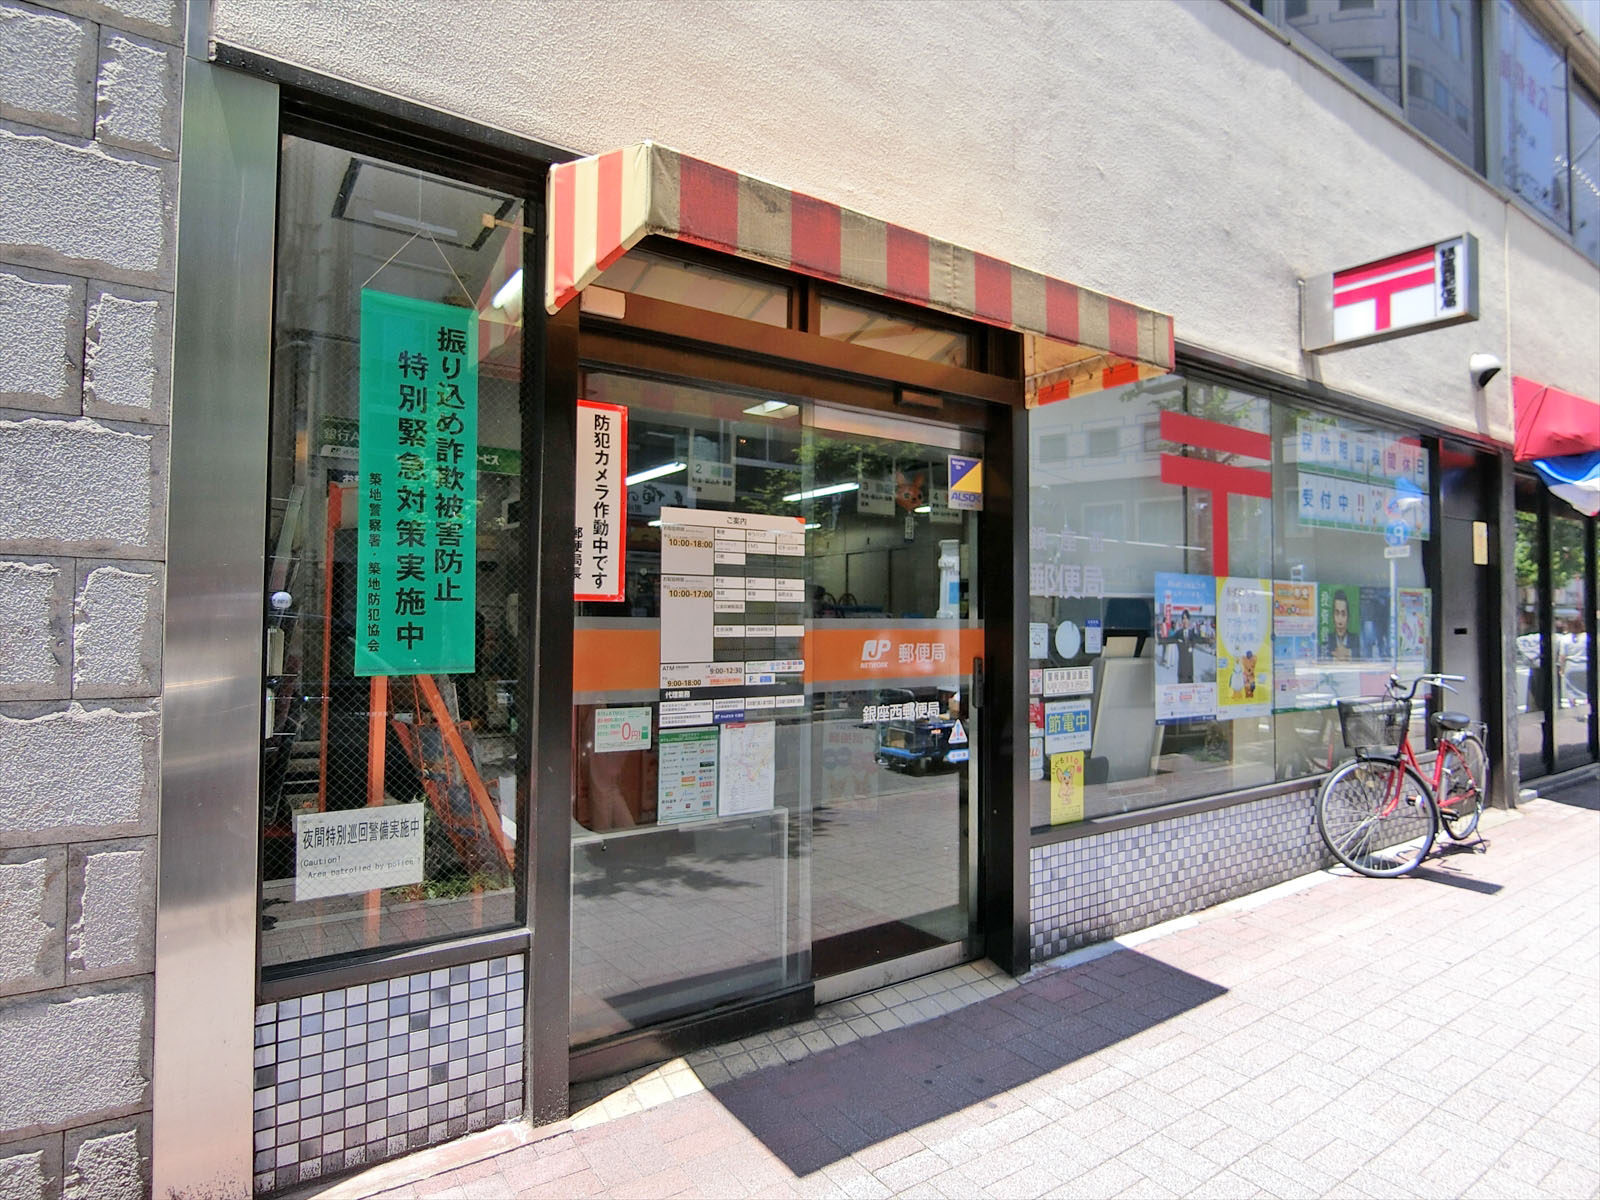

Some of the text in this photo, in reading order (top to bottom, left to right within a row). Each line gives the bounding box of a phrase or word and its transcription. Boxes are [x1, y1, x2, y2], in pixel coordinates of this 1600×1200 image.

[434, 326, 466, 602] 振り込め詐欺被害防止
[395, 350, 429, 651] 特別緊急対策実施中
[592, 414, 611, 589] 防犯カメラ作動中です
[726, 516, 747, 526] ご案内
[669, 538, 713, 548] 10:00-18:00
[1031, 563, 1105, 599] 郵便局
[669, 590, 713, 598] 10:00-17:00
[898, 643, 946, 663] 郵便局
[709, 667, 743, 675] 9:00-12:30
[667, 679, 702, 687] 9:00-18:00
[862, 701, 940, 723] 銀座西郵便局
[1048, 712, 1088, 734] 節電中
[303, 817, 420, 850] 夜間特別巡回警備実施中
